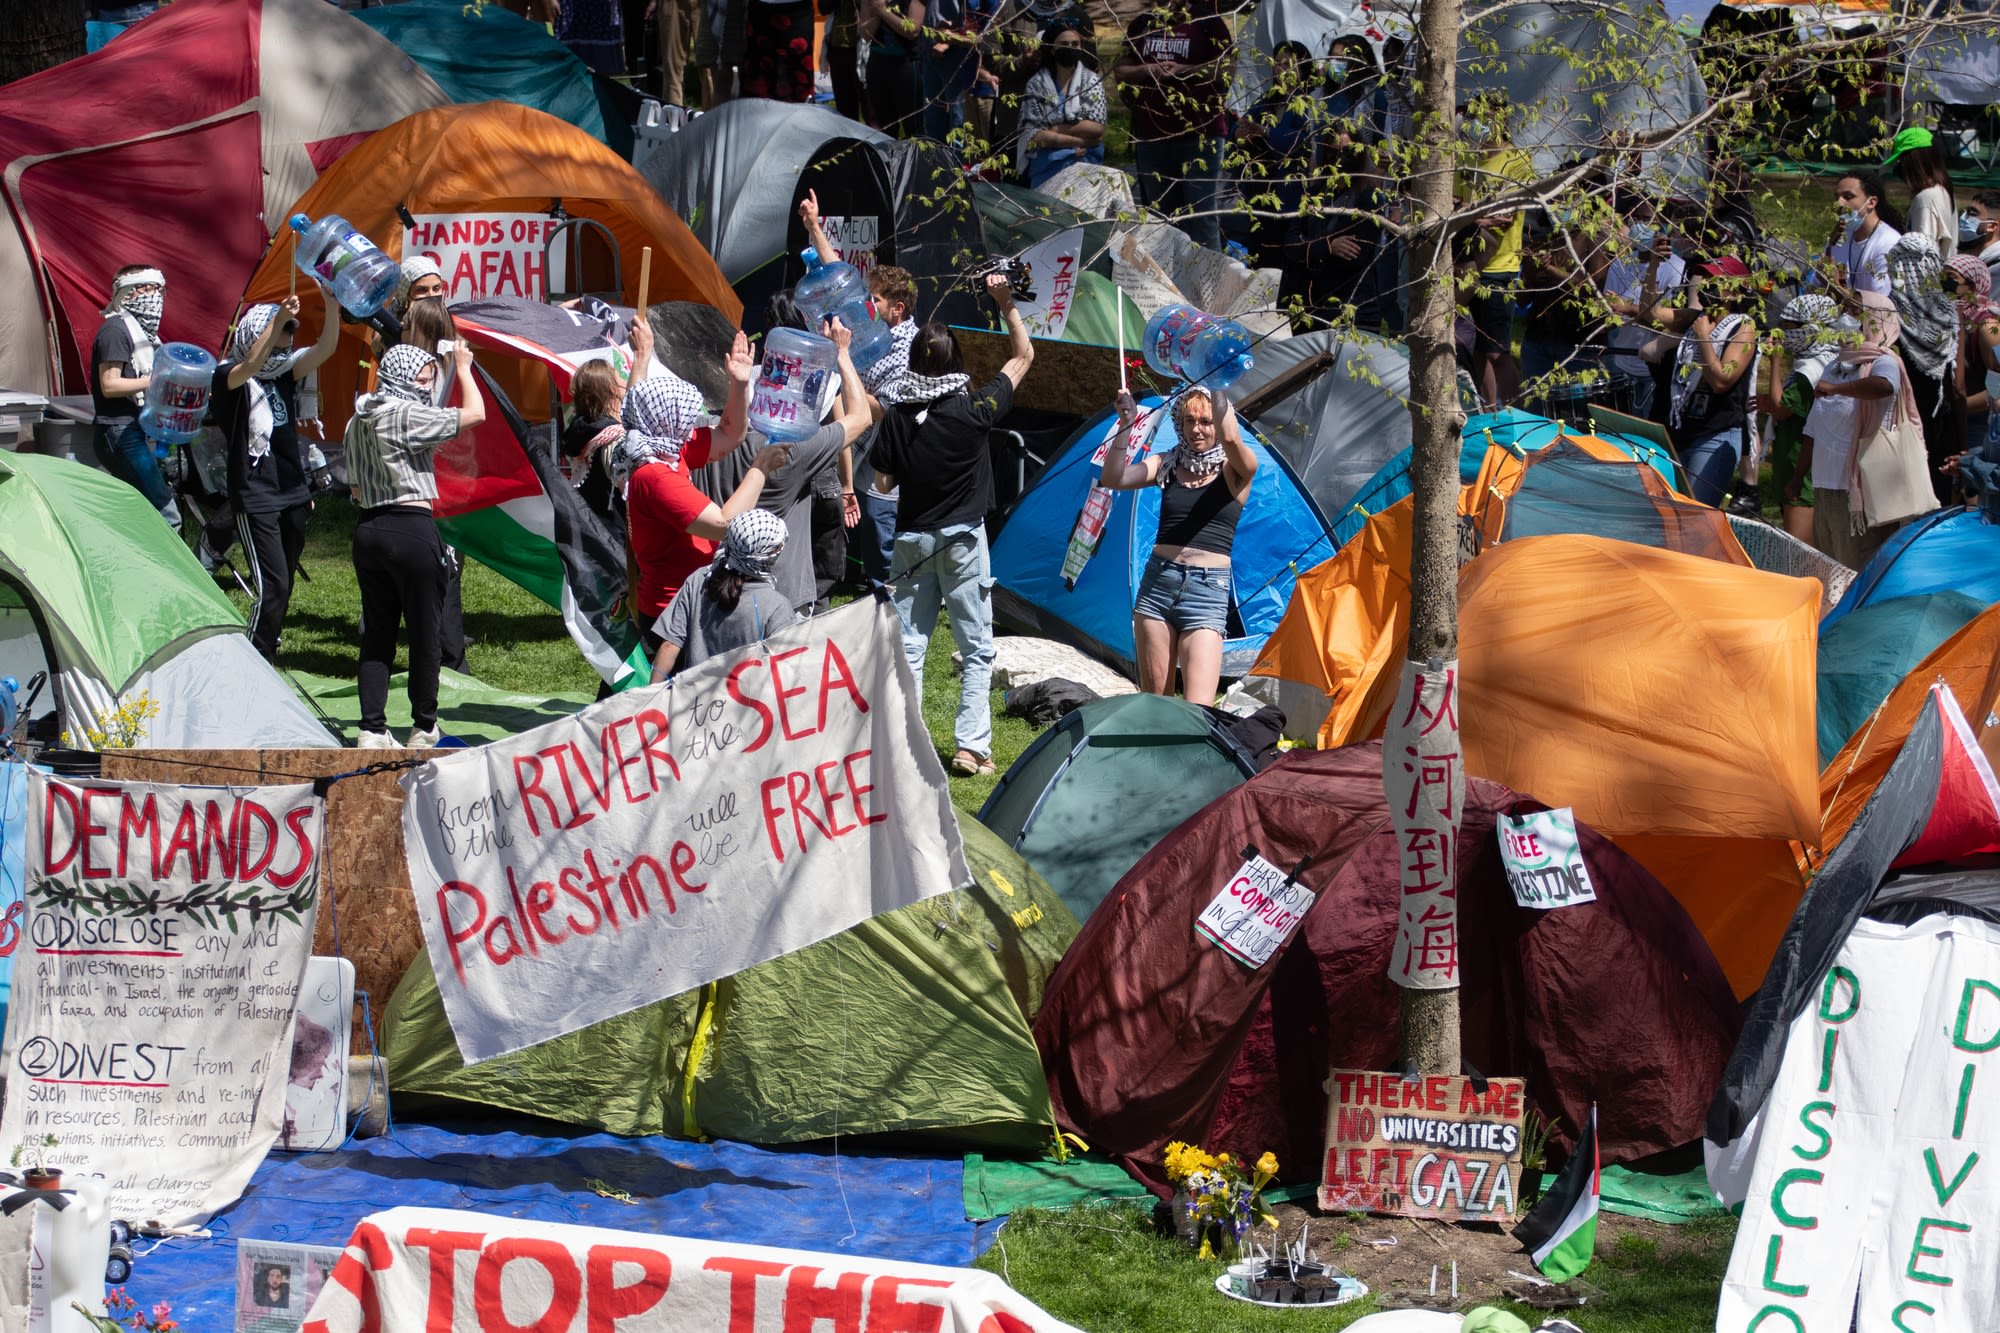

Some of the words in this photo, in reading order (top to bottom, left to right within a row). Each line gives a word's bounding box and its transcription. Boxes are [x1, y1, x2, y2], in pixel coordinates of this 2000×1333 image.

[411, 219, 504, 247] HANDS
[511, 219, 558, 244] OFF
[1046, 256, 1074, 324] MEDIC
[685, 695, 727, 731] to
[726, 637, 870, 754] SEA
[681, 723, 743, 765] the
[513, 708, 682, 838] RIVER
[437, 790, 513, 856] from
[685, 791, 740, 832] will
[760, 749, 888, 864] FREE
[1402, 669, 1459, 981] 从河到海
[44, 782, 314, 890] DEMANDS
[463, 823, 514, 862] the
[699, 831, 740, 867] be
[1504, 827, 1543, 858] FREE
[1245, 859, 1299, 904] HARVARD
[1295, 893, 1314, 913] IS
[436, 839, 708, 991] Palestine
[1208, 903, 1226, 921] IN
[195, 935, 231, 962] any
[242, 918, 280, 949] and
[37, 956, 56, 977] all
[181, 962, 252, 980] institutional
[263, 960, 280, 976] &
[40, 1000, 52, 1017] in
[104, 1003, 128, 1018] and
[139, 1003, 205, 1023] occupation
[214, 1003, 226, 1017] of
[238, 1002, 294, 1021] Palestine
[106, 981, 118, 997] in
[177, 983, 196, 1000] the
[203, 983, 239, 1003] ongoing
[248, 980, 299, 1001] genocide
[192, 1046, 234, 1076] from
[251, 1051, 273, 1074] all
[80, 1085, 163, 1104] investments
[177, 1086, 206, 1104] and
[1334, 1073, 1449, 1112] THERE
[1459, 1079, 1522, 1119] ARE
[25, 1106, 39, 1126] in
[134, 1107, 207, 1127] Palestinian
[1337, 1107, 1375, 1143] NO
[1380, 1117, 1517, 1153] UNIVERSITIES
[113, 1173, 138, 1190] all
[1326, 1147, 1414, 1187] LEFT
[1382, 1187, 1403, 1210] in
[1411, 1153, 1514, 1216] GAZA
[295, 1222, 672, 1333] STOP
[703, 1256, 954, 1333] THE
